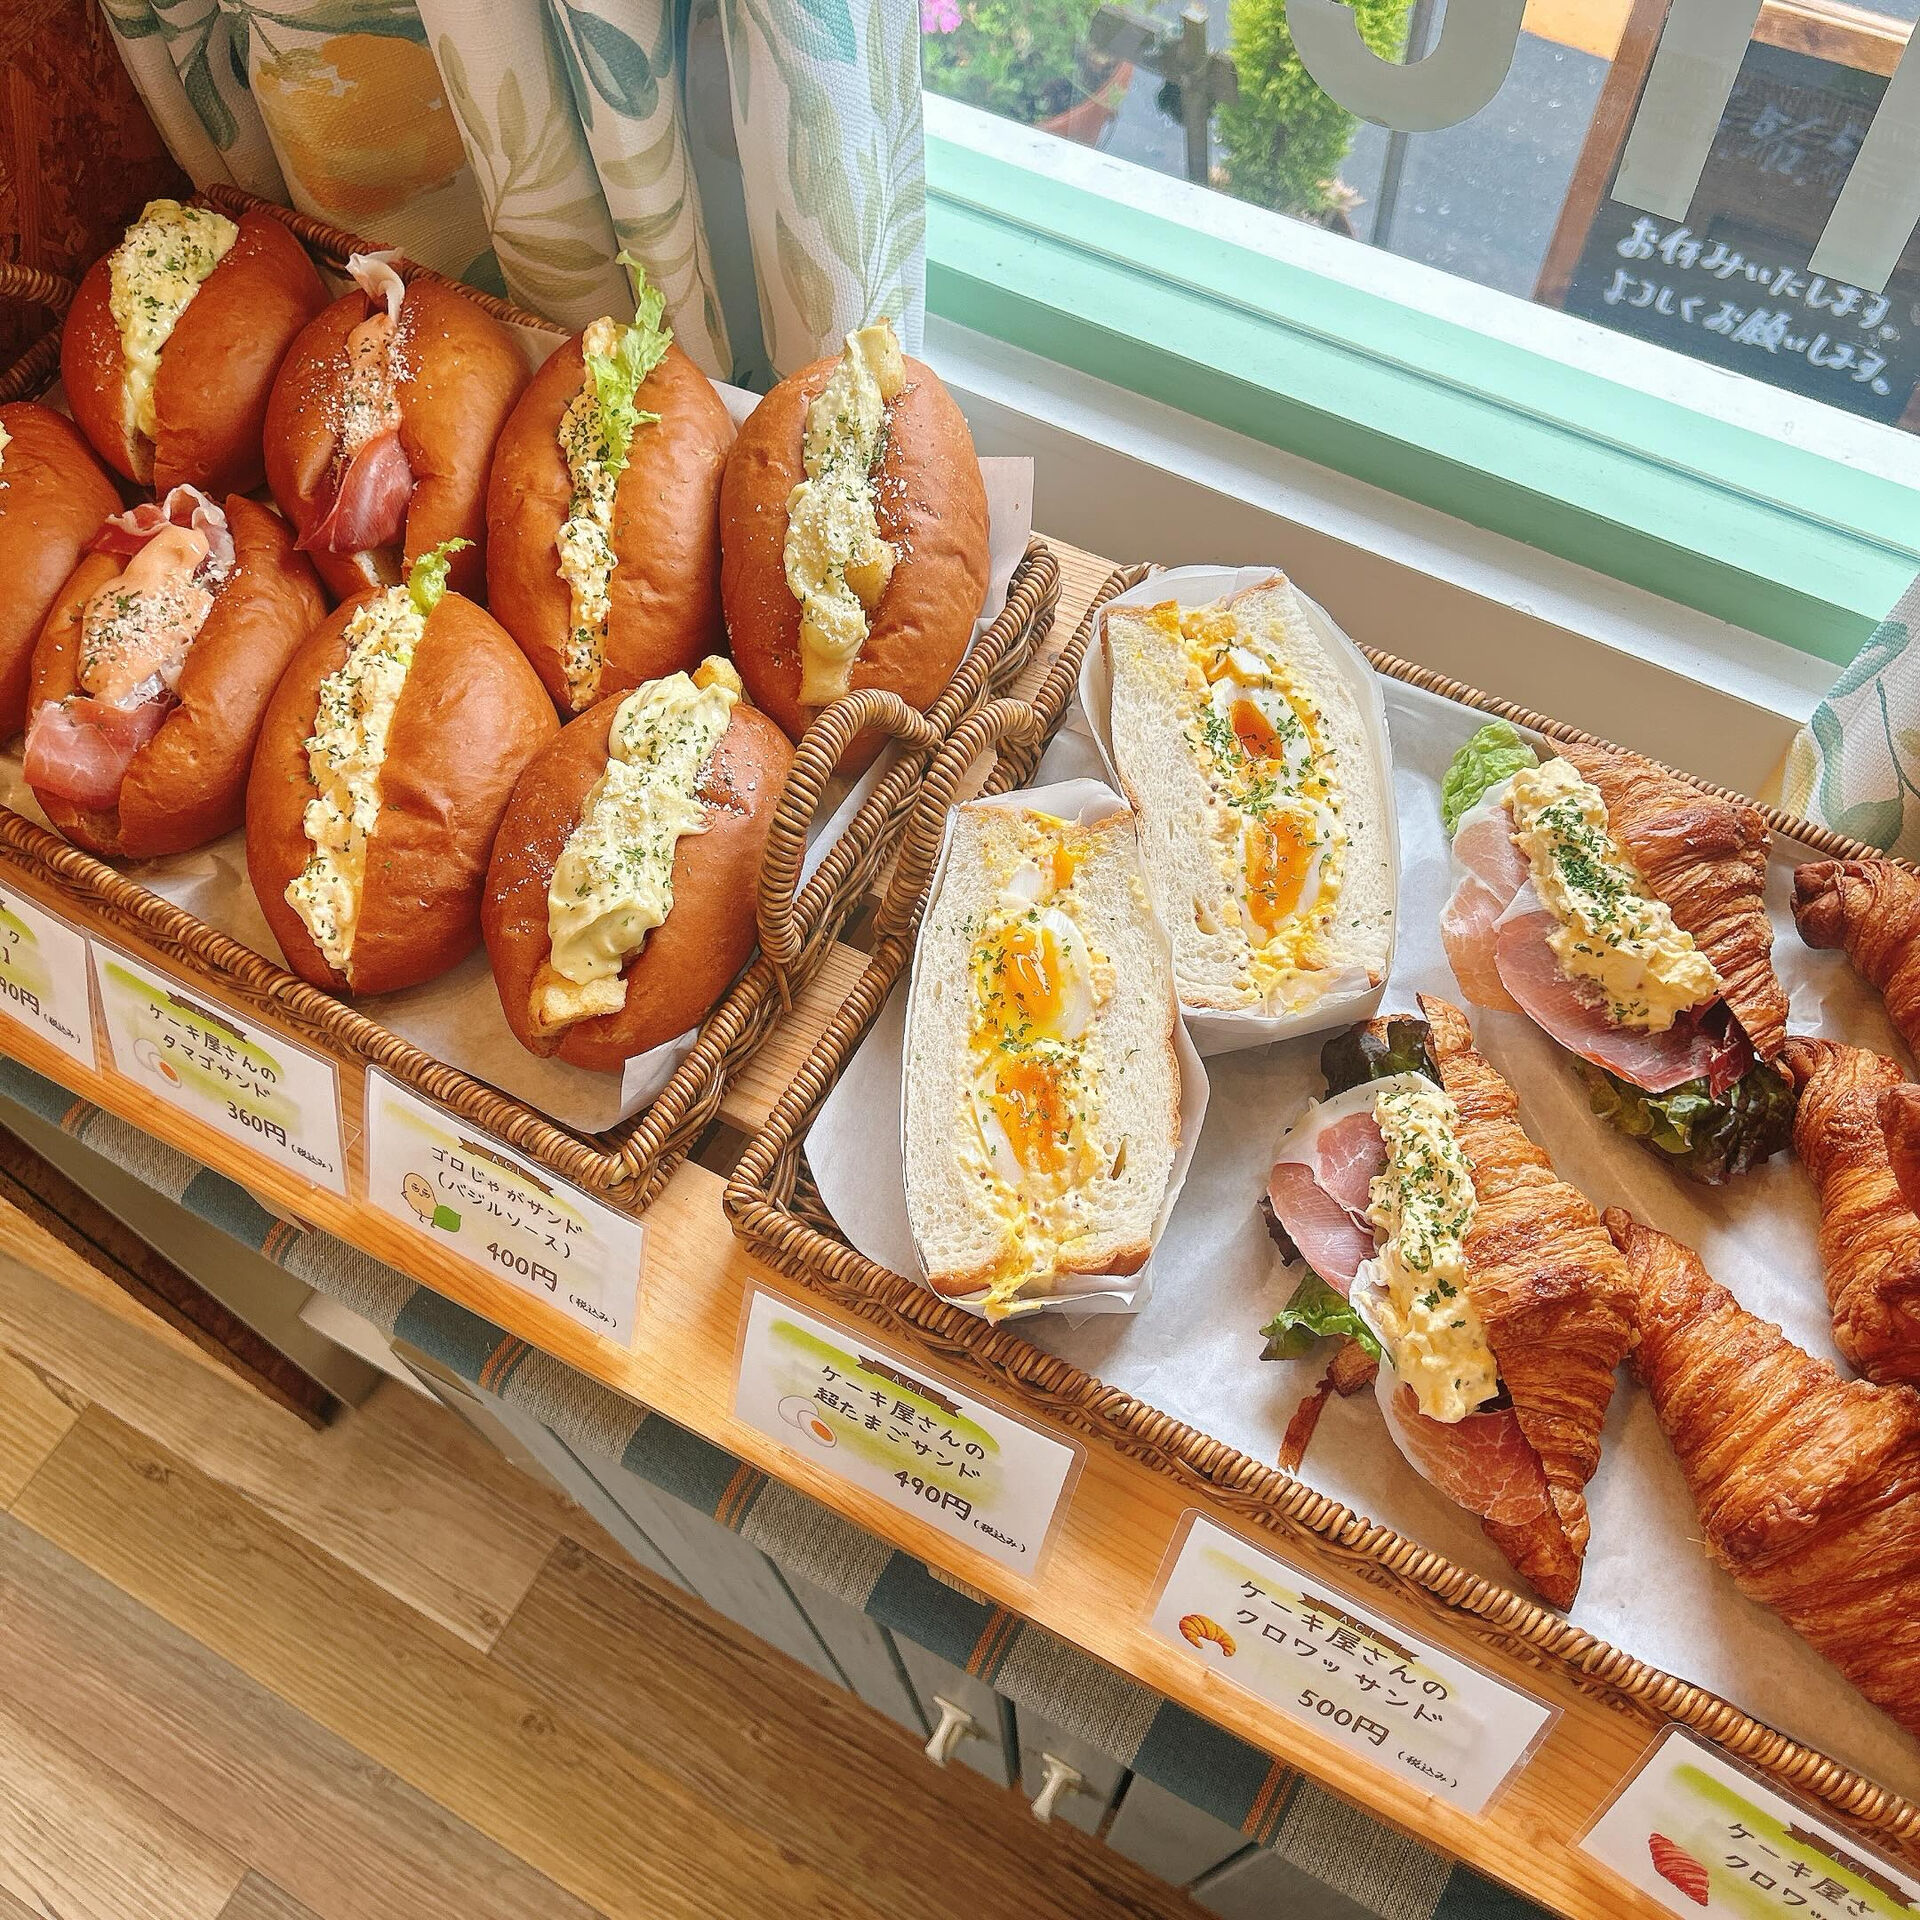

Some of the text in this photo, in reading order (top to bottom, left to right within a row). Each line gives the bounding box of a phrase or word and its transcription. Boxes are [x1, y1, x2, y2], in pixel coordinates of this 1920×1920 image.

[150, 1003, 277, 1083] ケーキ屋さんの
[163, 1035, 271, 1098] タマゴサンド
[227, 1101, 287, 1147] 360円
[431, 1146, 583, 1235] ゴロじゃがサンド
[438, 1171, 571, 1259] （バジルソース）
[487, 1242, 617, 1328] 400円 （税込み）
[813, 1387, 981, 1479] 超たまごサンド
[822, 1365, 985, 1460] ケーキ屋さんの
[894, 1470, 1026, 1553] 490円 （税込み）
[1236, 1608, 1443, 1724] クロワッサンド
[1240, 1580, 1448, 1702] ケーキ屋さんの
[1297, 1688, 1458, 1789] 500円 （税込み）
[1728, 1823, 1875, 1916] ケーキ屋さ
